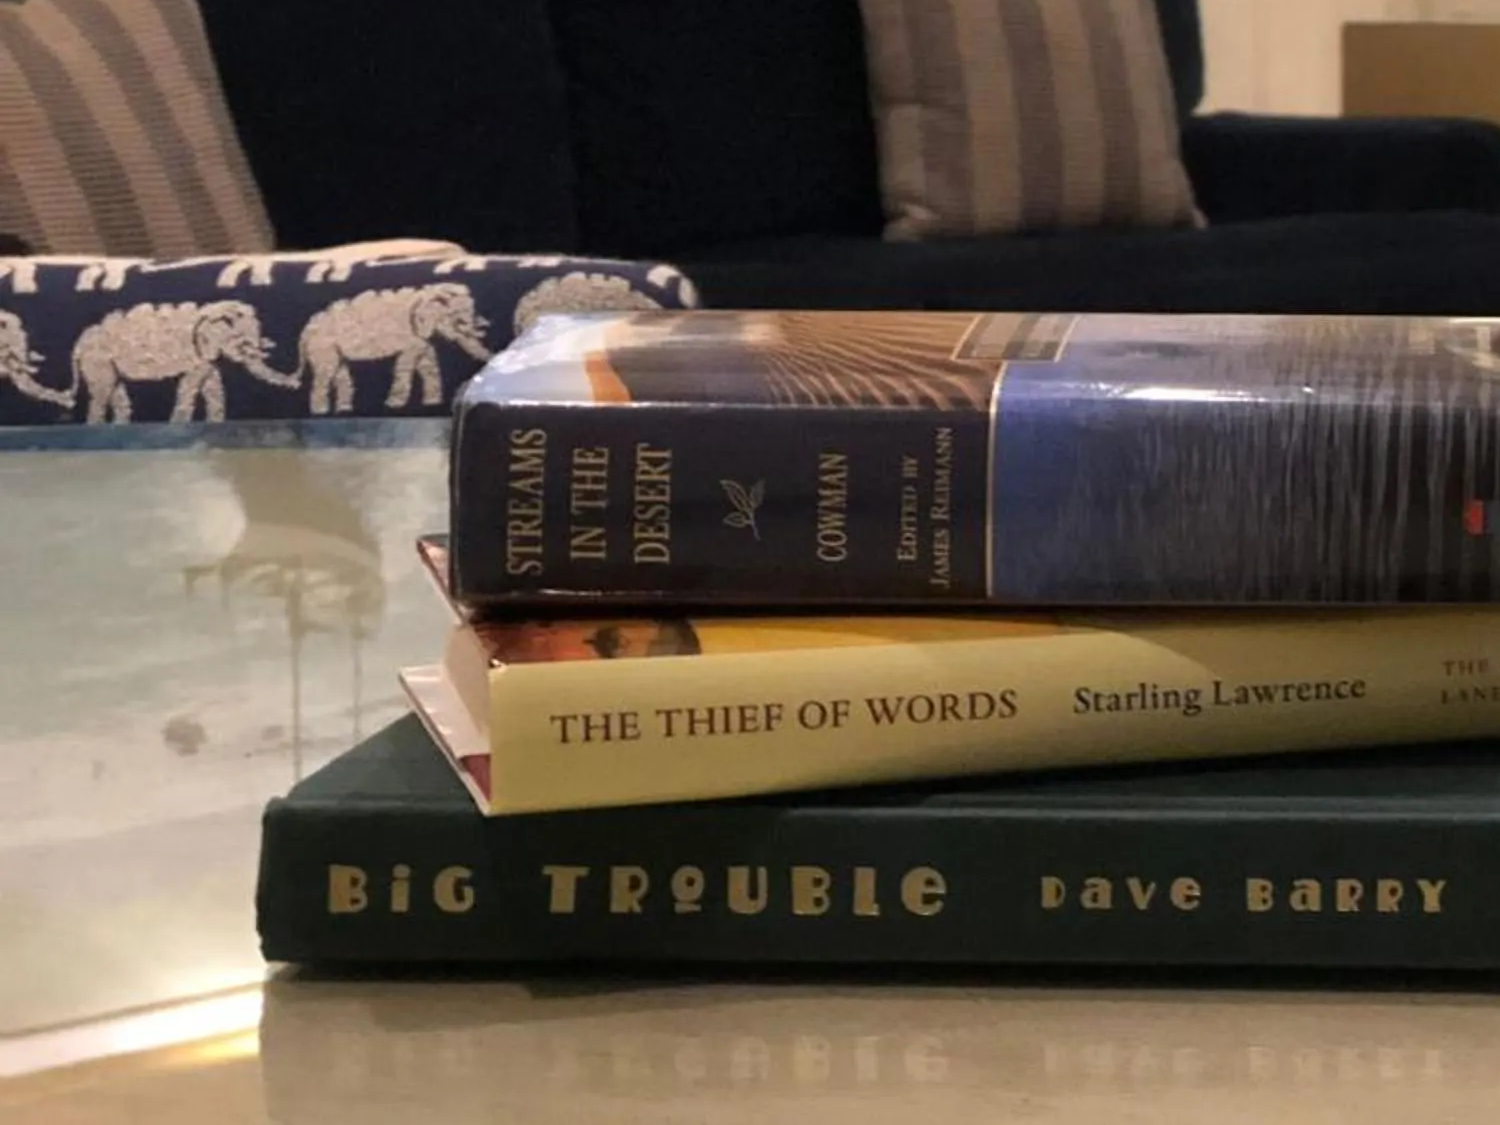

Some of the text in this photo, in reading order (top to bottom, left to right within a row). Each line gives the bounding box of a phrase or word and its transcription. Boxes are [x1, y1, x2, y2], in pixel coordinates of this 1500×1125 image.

[507, 428, 547, 574] STREAMS
[571, 445, 609, 561] IN THE
[634, 442, 672, 564] DESERT
[817, 451, 848, 562] COWMAN
[929, 428, 952, 588] JAMES REIMANN
[551, 688, 1018, 744] THE THIEF OF WORDS
[1073, 678, 1367, 715] Starling Lawrence
[1441, 658, 1490, 677] THE
